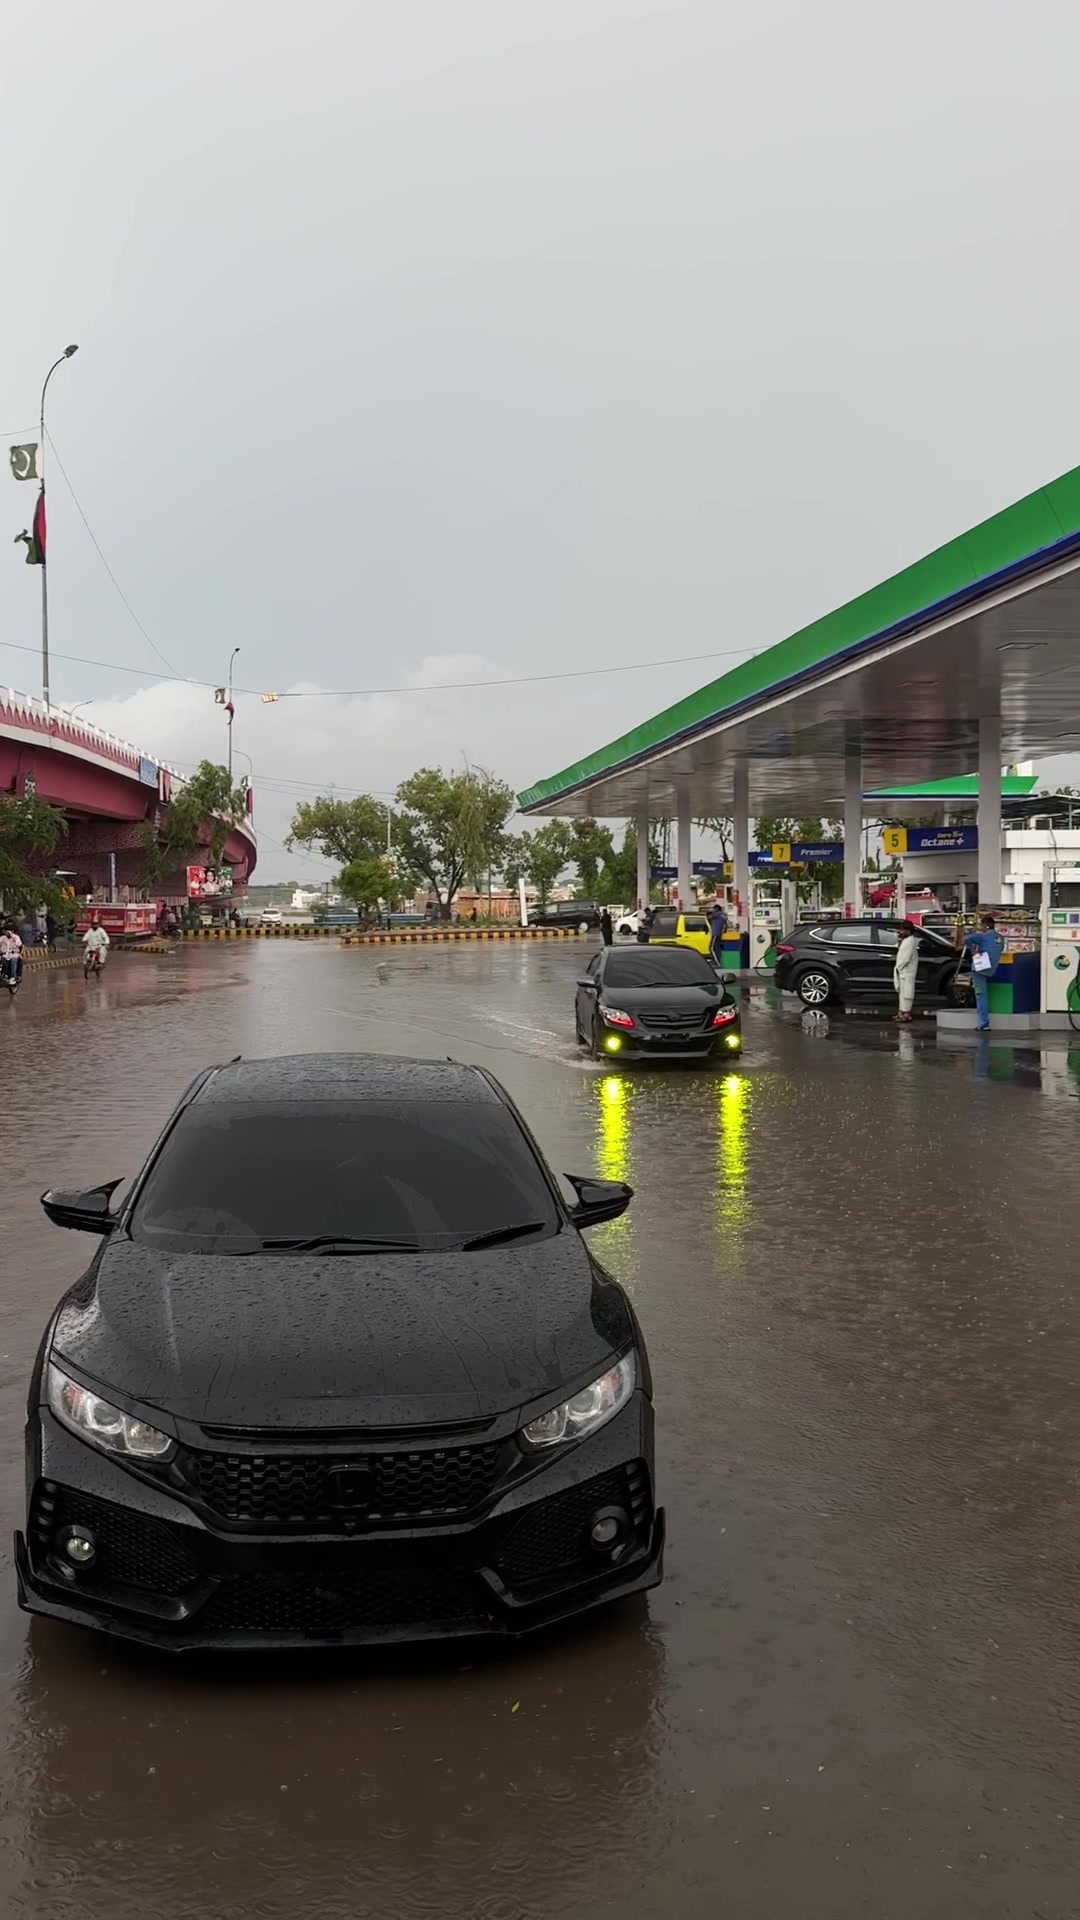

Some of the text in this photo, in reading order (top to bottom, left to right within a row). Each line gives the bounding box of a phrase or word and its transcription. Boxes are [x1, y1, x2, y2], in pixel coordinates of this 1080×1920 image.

[891, 833, 899, 847] 5
[778, 847, 784, 858] 7
[800, 848, 833, 856] Premier
